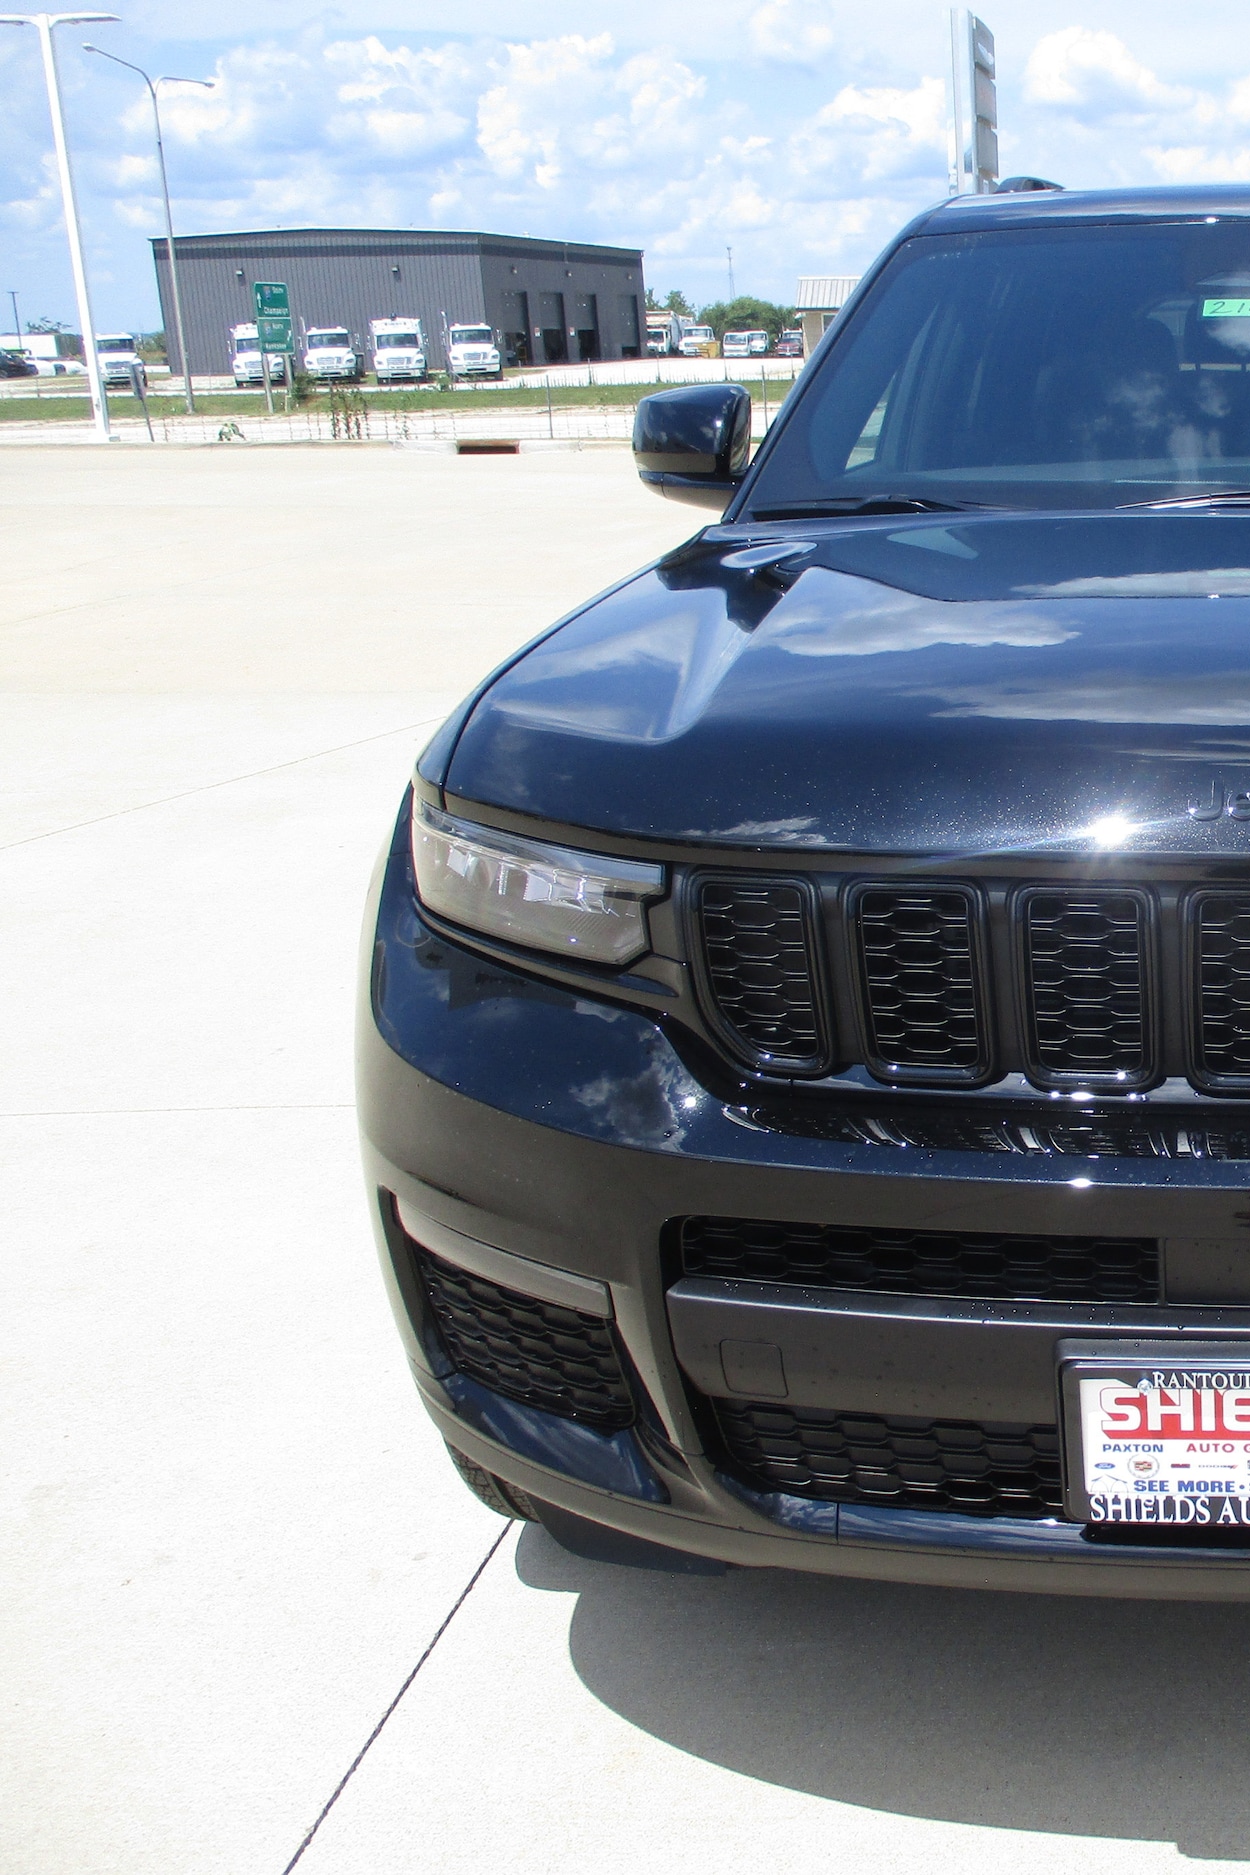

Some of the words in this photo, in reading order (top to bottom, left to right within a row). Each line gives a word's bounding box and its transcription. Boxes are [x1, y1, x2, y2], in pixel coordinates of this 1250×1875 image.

[1102, 1443, 1164, 1453] PAXTON
[1186, 1443, 1235, 1453] AUTO
[1133, 1480, 1170, 1492] SEE
[1177, 1480, 1236, 1493] MORE
[1089, 1494, 1210, 1525] SHIELDS
